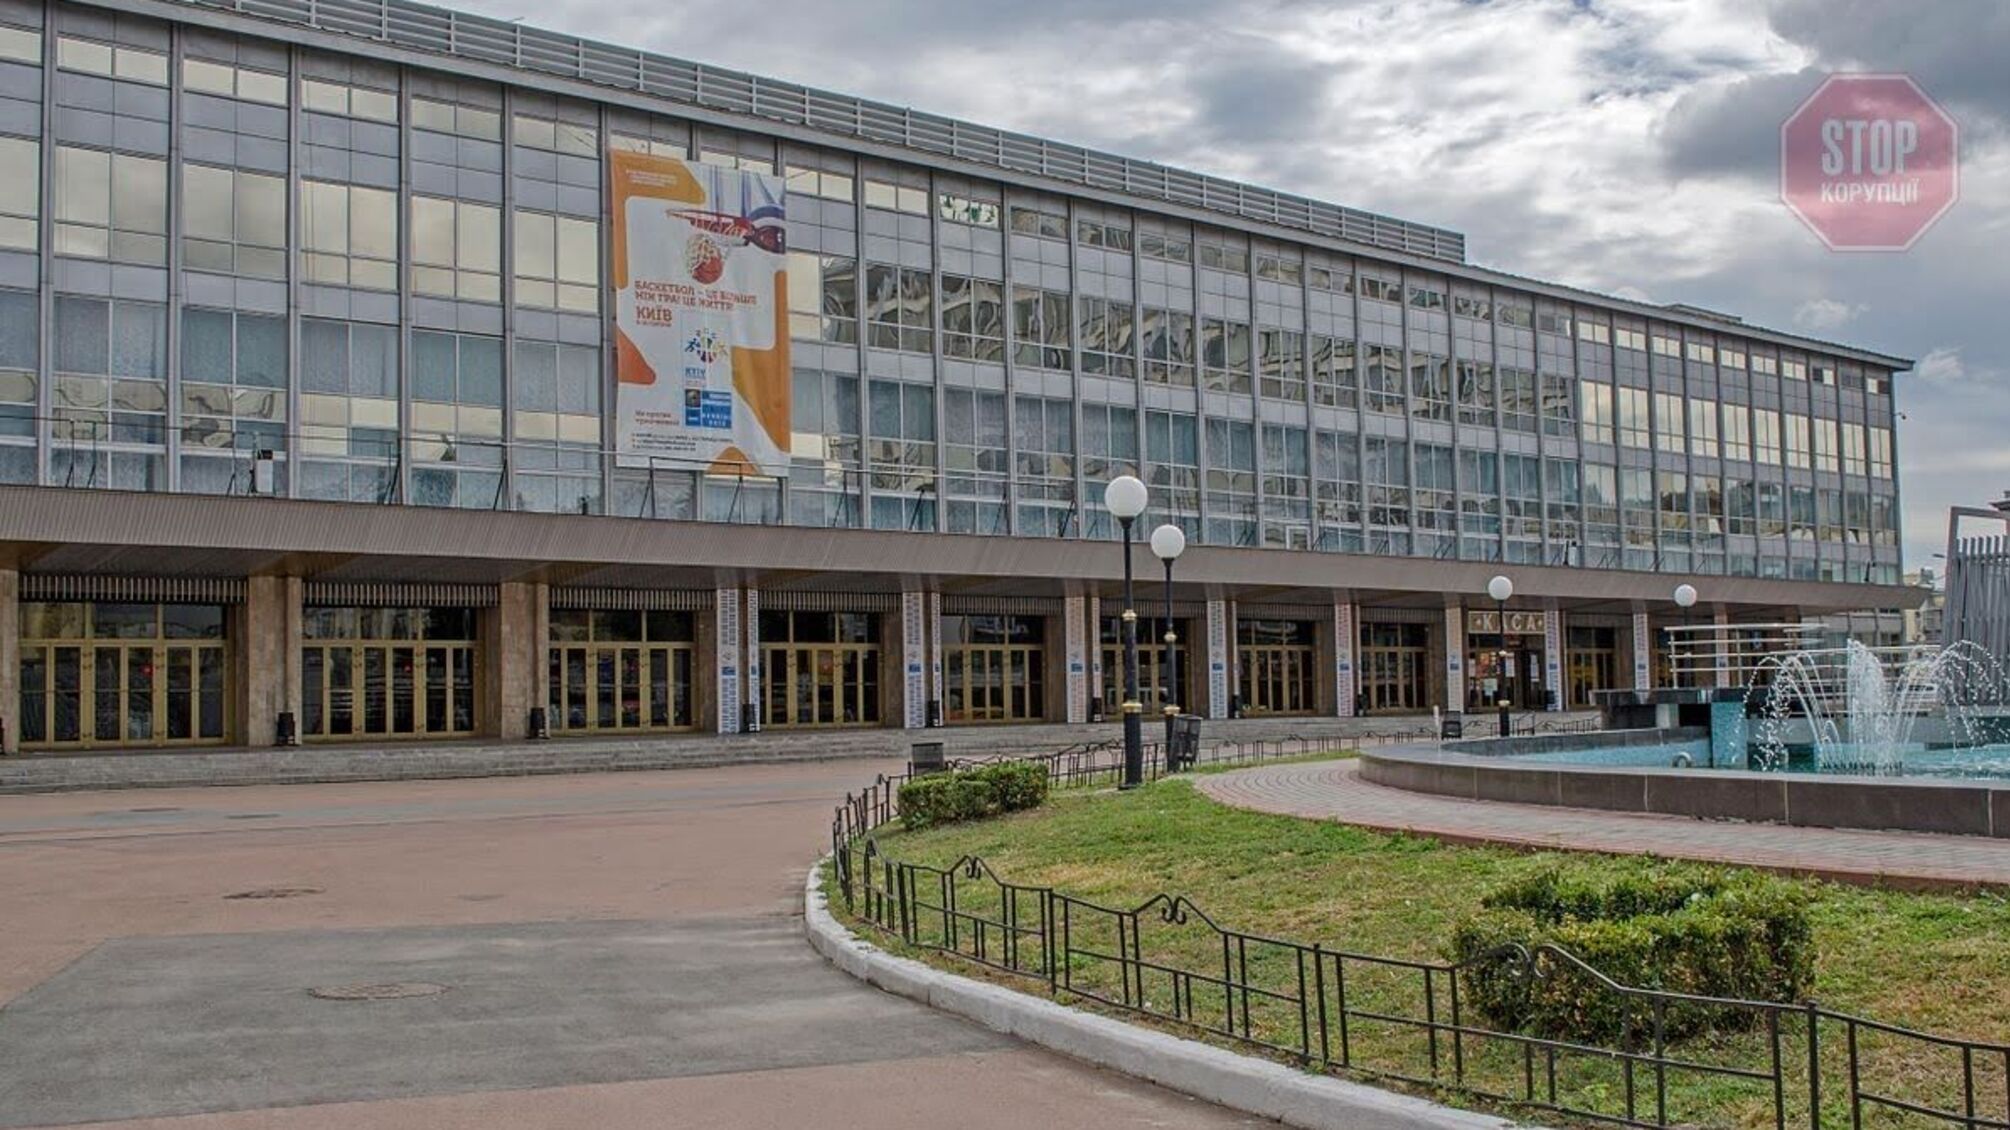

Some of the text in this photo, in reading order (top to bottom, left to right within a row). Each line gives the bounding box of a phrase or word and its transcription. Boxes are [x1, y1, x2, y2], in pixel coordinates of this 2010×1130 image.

[635, 281, 695, 295] БАСКЕТБОЛ
[682, 296, 696, 307] ЦЕ
[636, 305, 673, 322] КИЇВ
